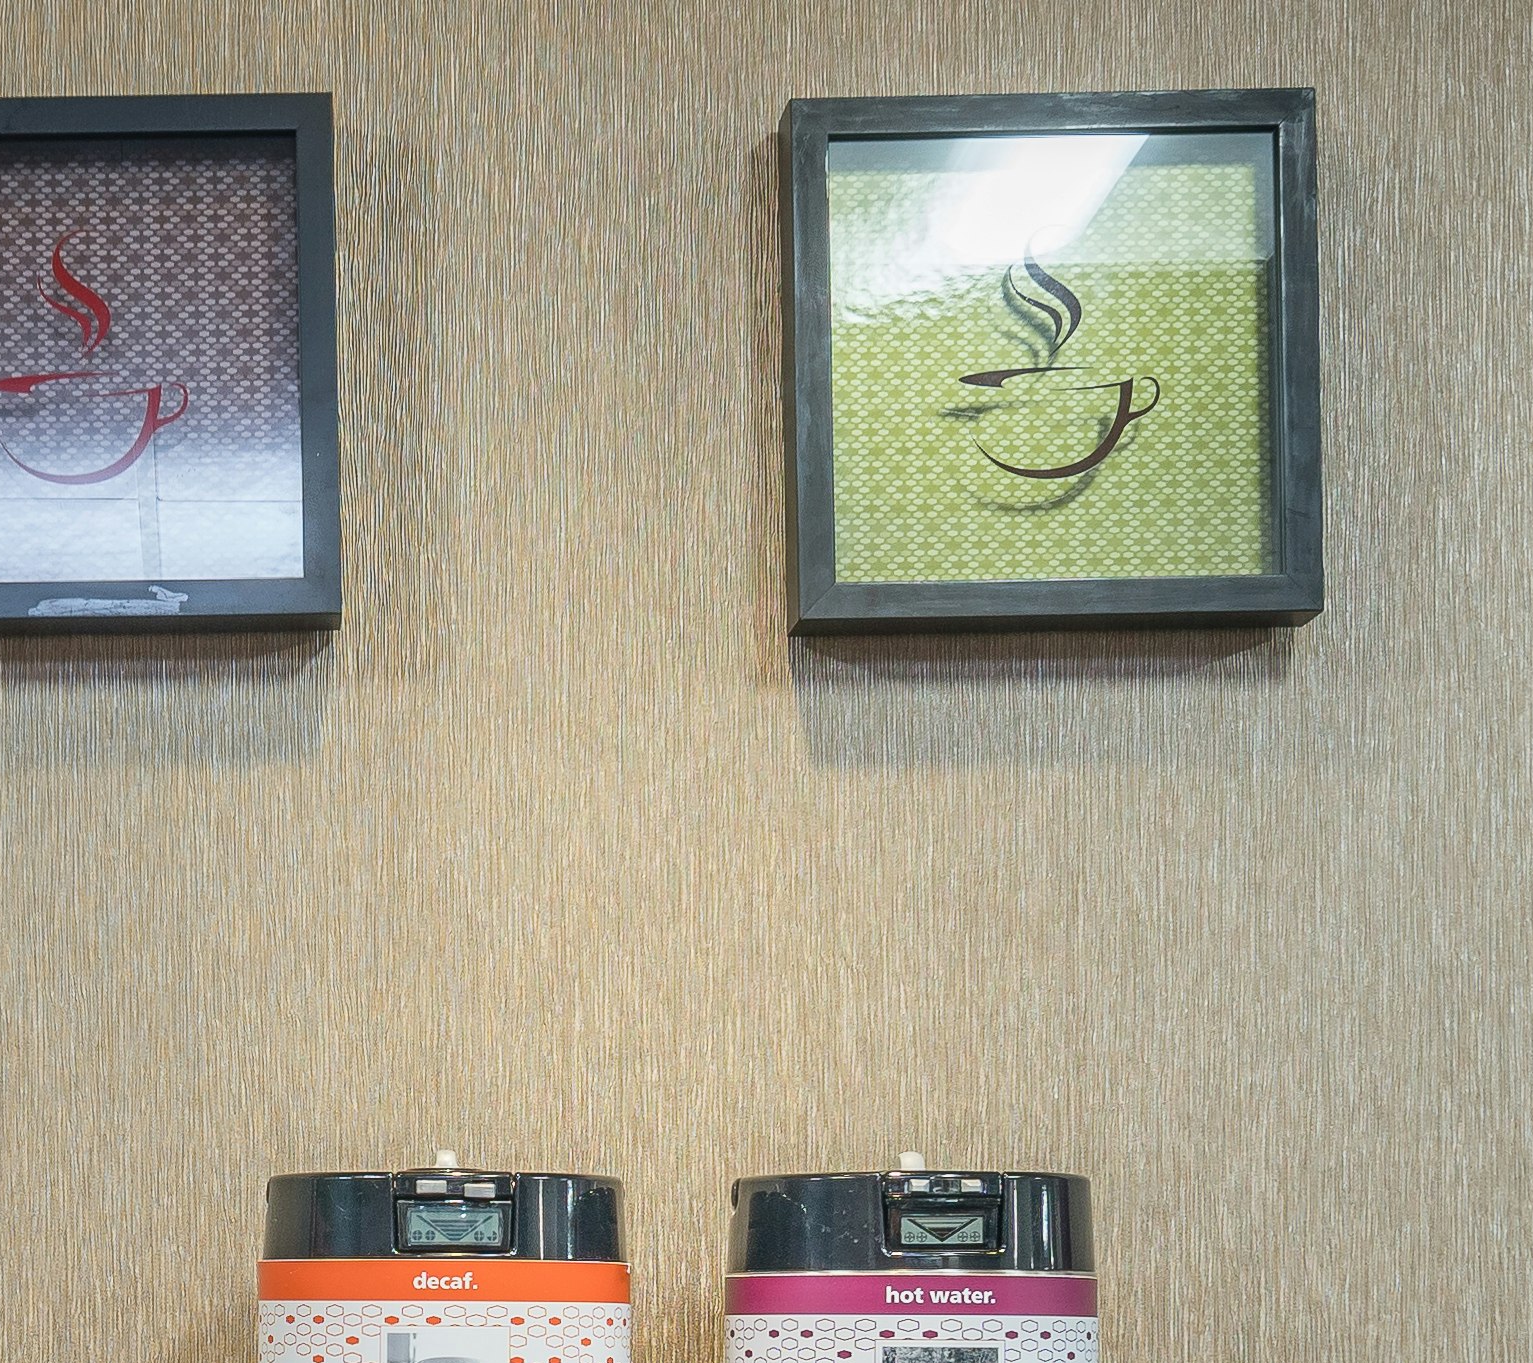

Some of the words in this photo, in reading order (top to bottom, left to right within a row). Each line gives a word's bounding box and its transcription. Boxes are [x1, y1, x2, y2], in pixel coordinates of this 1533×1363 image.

[412, 1271, 479, 1290] decaf.
[885, 1285, 924, 1304] hot
[929, 1287, 996, 1304] water.
